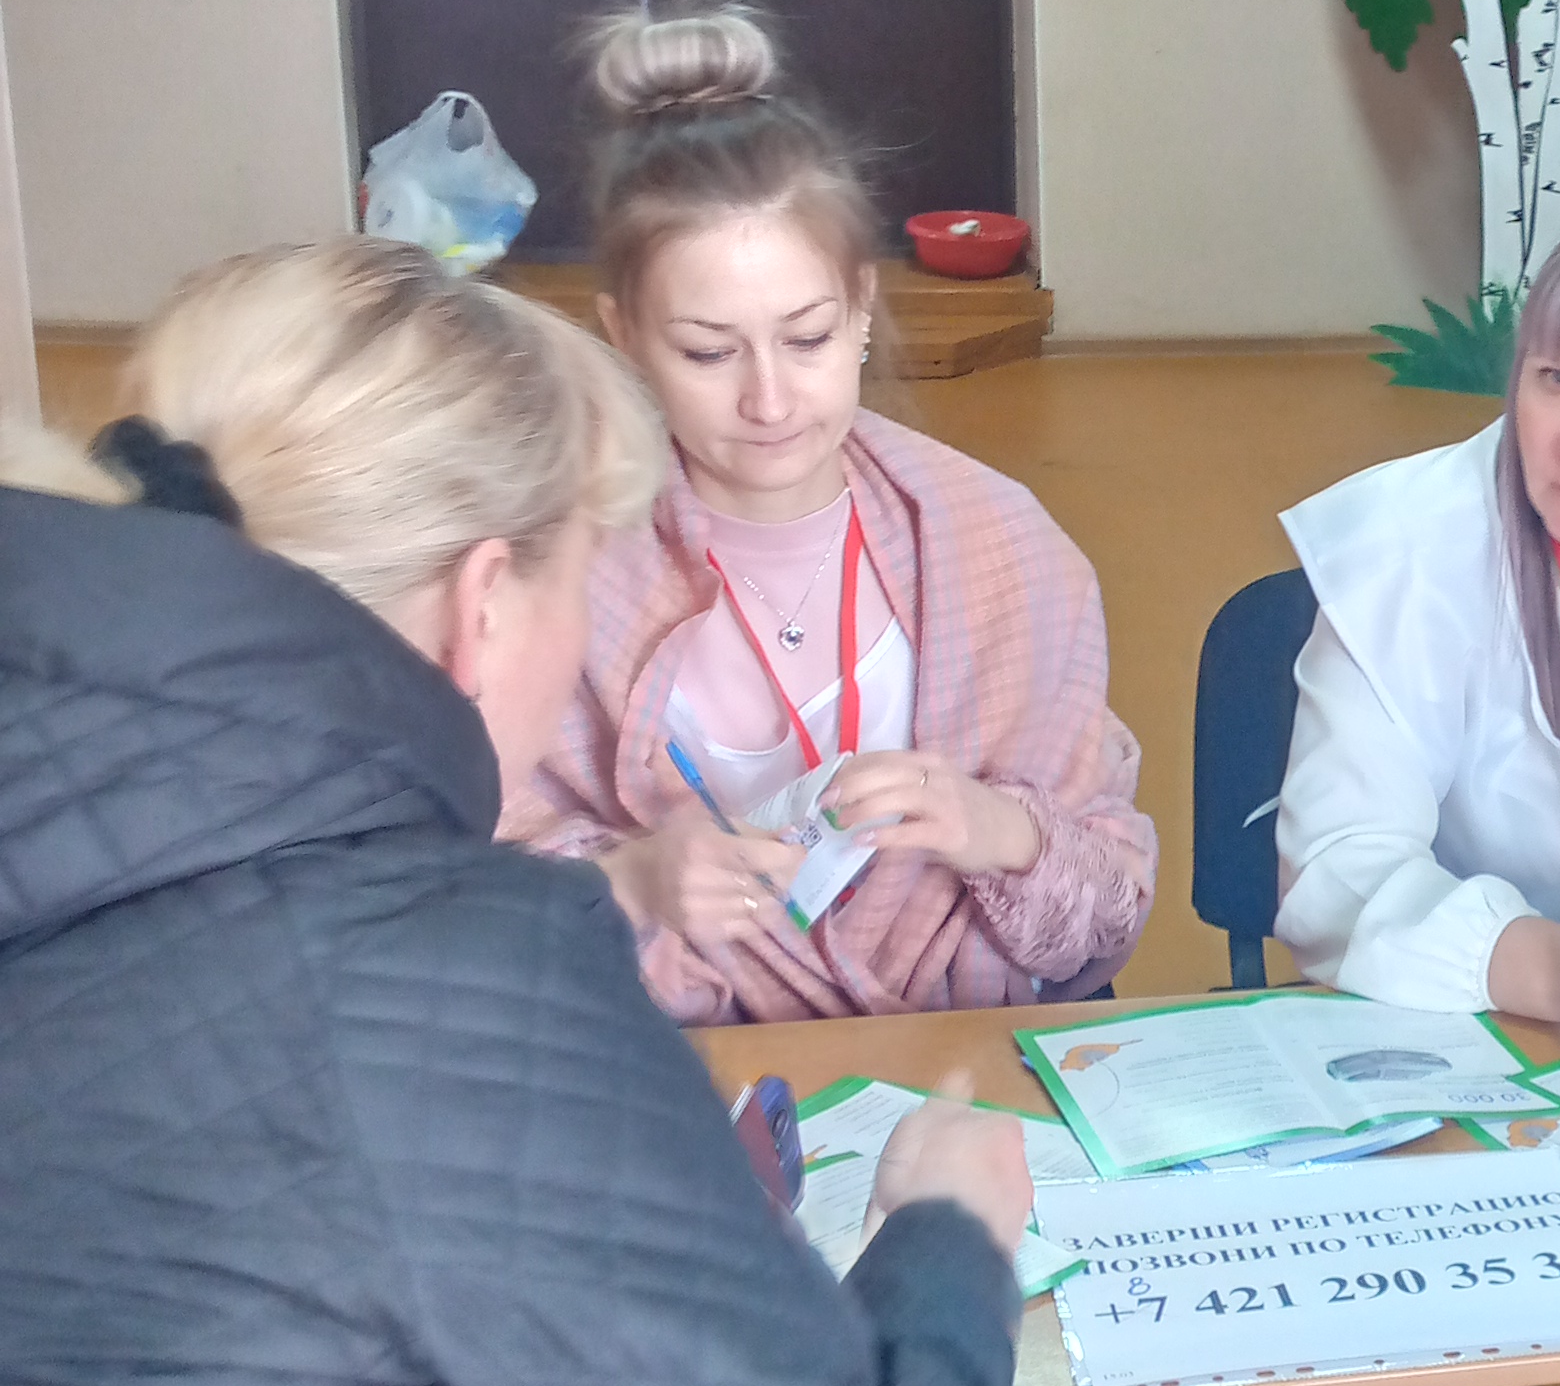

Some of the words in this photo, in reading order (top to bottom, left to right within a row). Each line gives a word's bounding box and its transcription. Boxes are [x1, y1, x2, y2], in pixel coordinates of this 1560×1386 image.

[1062, 1221, 1260, 1253] ЗАВЕРШИ
[1082, 1244, 1278, 1276] ПОЗВОНИ
[1287, 1237, 1347, 1257] ПО
[1094, 1295, 1168, 1324] +7
[1194, 1282, 1301, 1316] 421
[1319, 1268, 1427, 1303] 290
[1445, 1257, 1516, 1290] 35
[1127, 1276, 1152, 1297] 8
